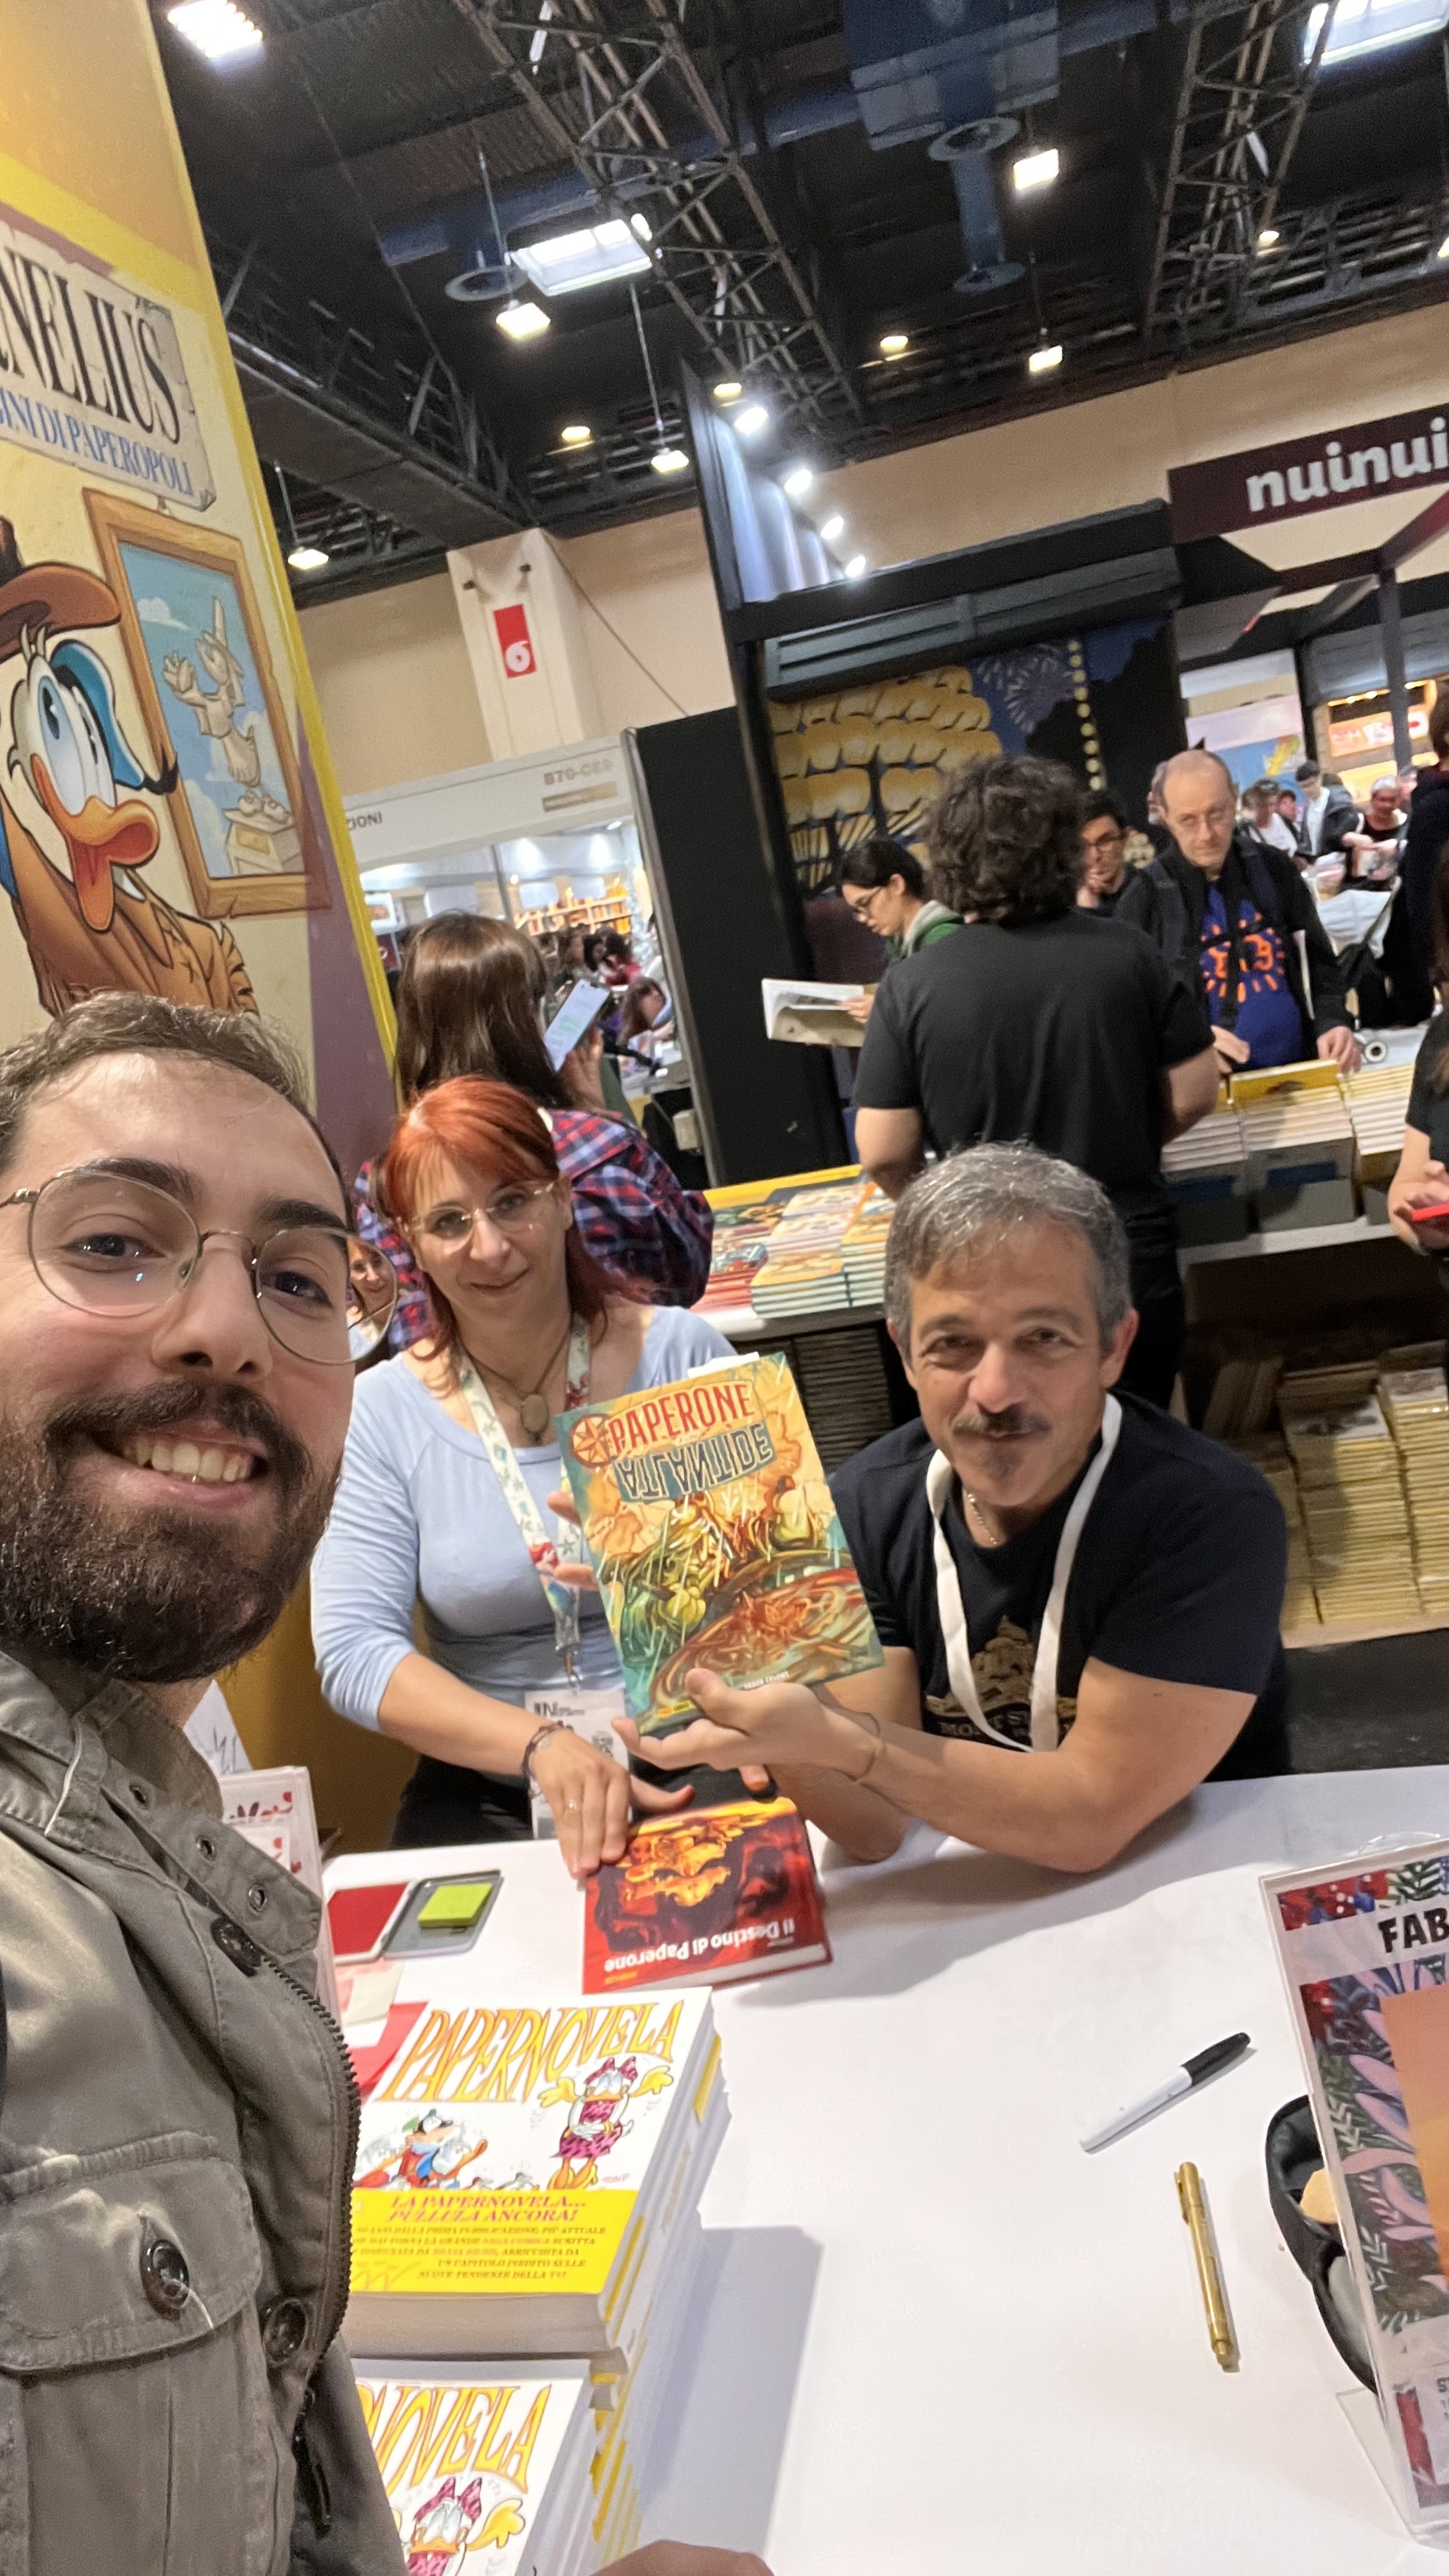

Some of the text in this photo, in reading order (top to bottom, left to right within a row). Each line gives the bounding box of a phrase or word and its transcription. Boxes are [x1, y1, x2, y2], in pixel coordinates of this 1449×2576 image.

[0, 245, 180, 445] NELIUS
[65, 413, 194, 496] PAPEROPOLI
[1246, 417, 1448, 512] nuinui
[505, 640, 530, 673] 6
[608, 1384, 755, 1455] PAPERONE
[604, 1942, 690, 1972] Paperone
[1377, 1907, 1449, 1953] FAB
[372, 1999, 685, 2104] PAPERNOVELA
